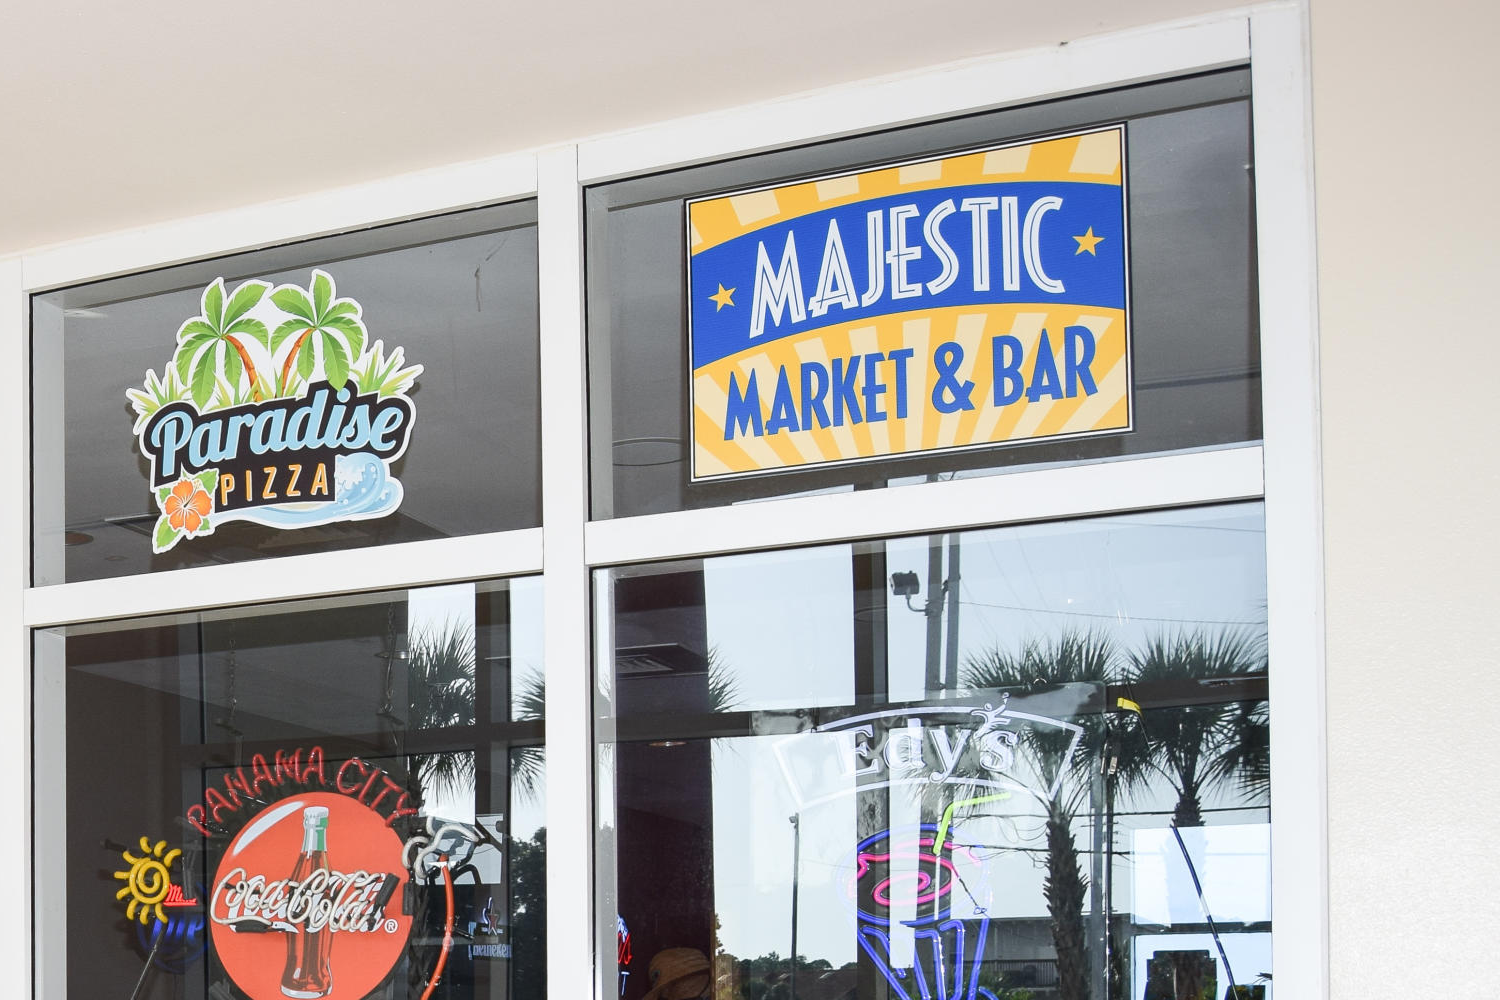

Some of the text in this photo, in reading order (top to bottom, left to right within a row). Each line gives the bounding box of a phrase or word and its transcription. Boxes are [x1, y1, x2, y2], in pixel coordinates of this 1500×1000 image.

[749, 195, 1066, 339] MAJESTIC
[723, 324, 1098, 442] MARKET & BAR
[151, 387, 404, 478] Paradise
[220, 462, 329, 506] PIZZA
[187, 746, 418, 838] PANAMA CITY
[835, 712, 1020, 783] Edy's
